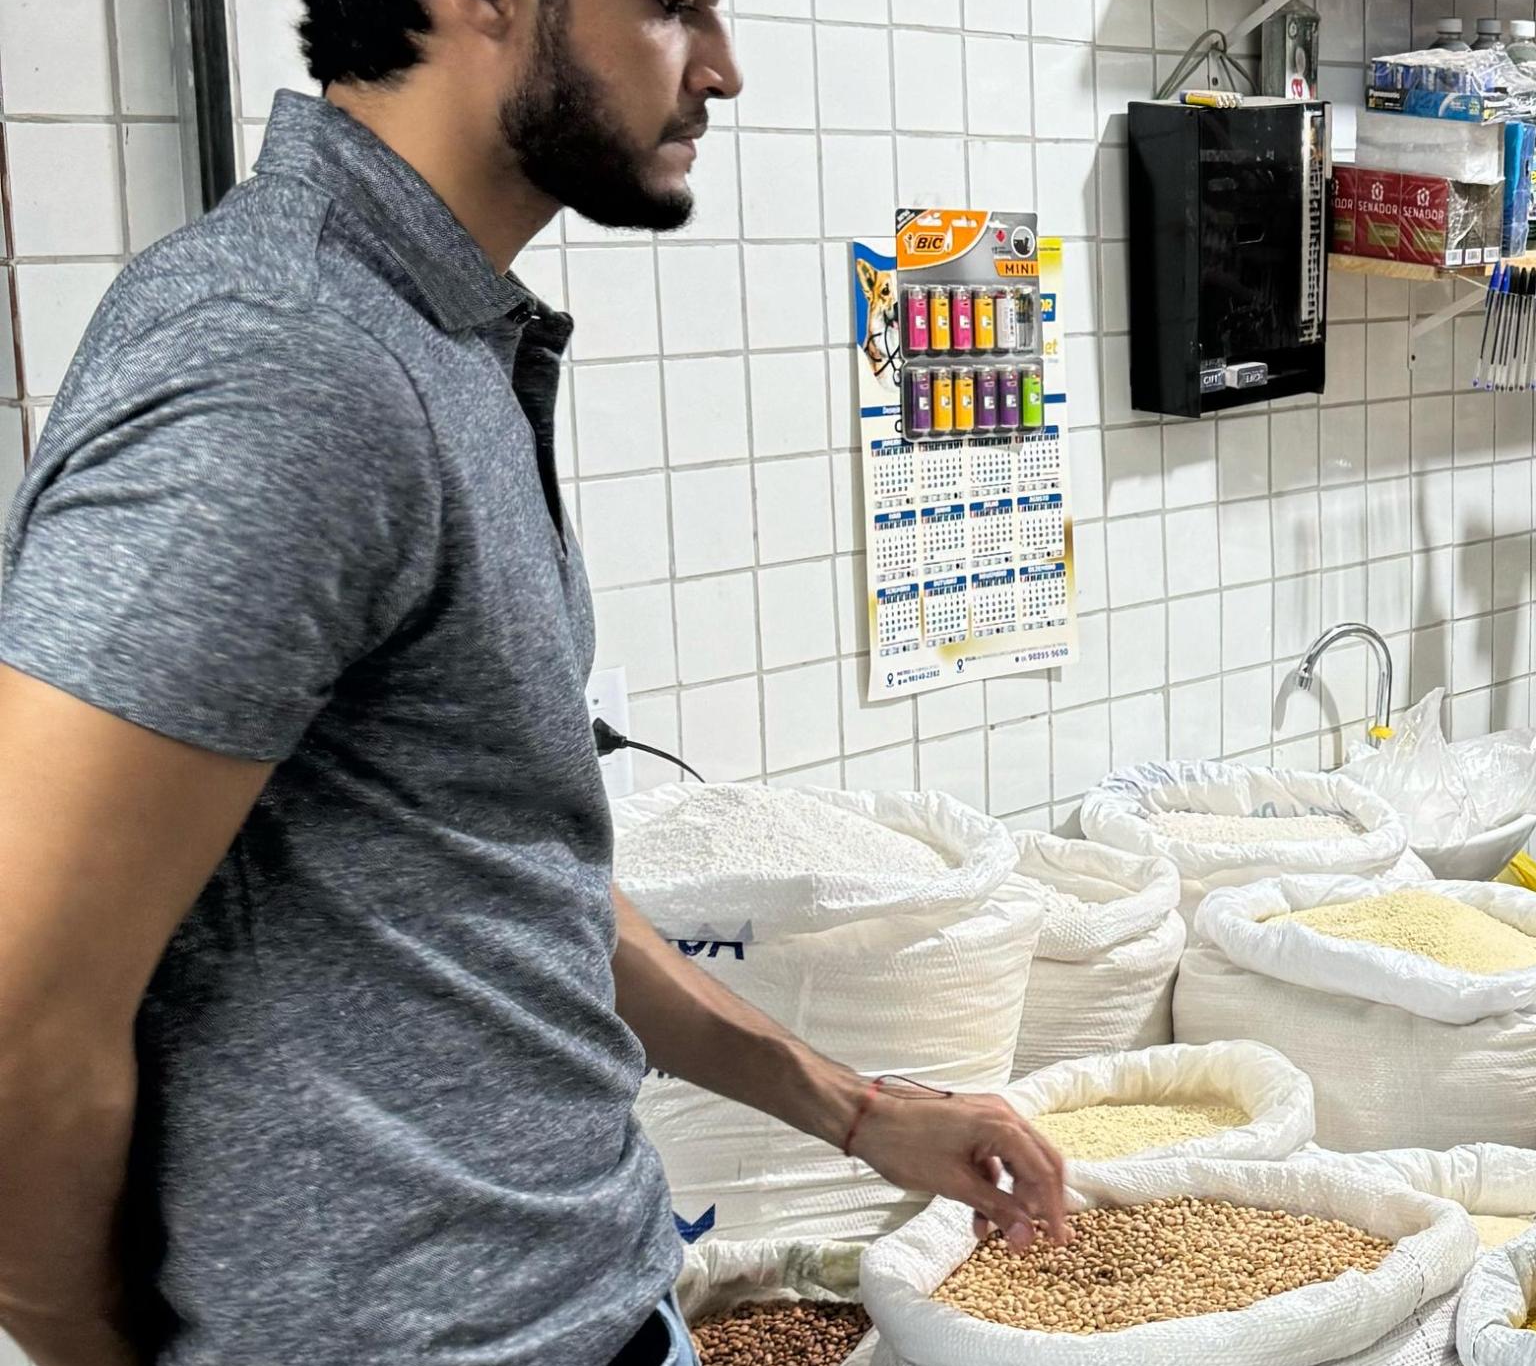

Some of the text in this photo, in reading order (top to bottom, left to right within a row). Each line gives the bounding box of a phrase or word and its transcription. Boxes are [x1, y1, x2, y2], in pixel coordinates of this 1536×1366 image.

[1357, 199, 1398, 216] SENADOR
[1402, 206, 1445, 222] SENADOR
[1005, 264, 1035, 275] MINI
